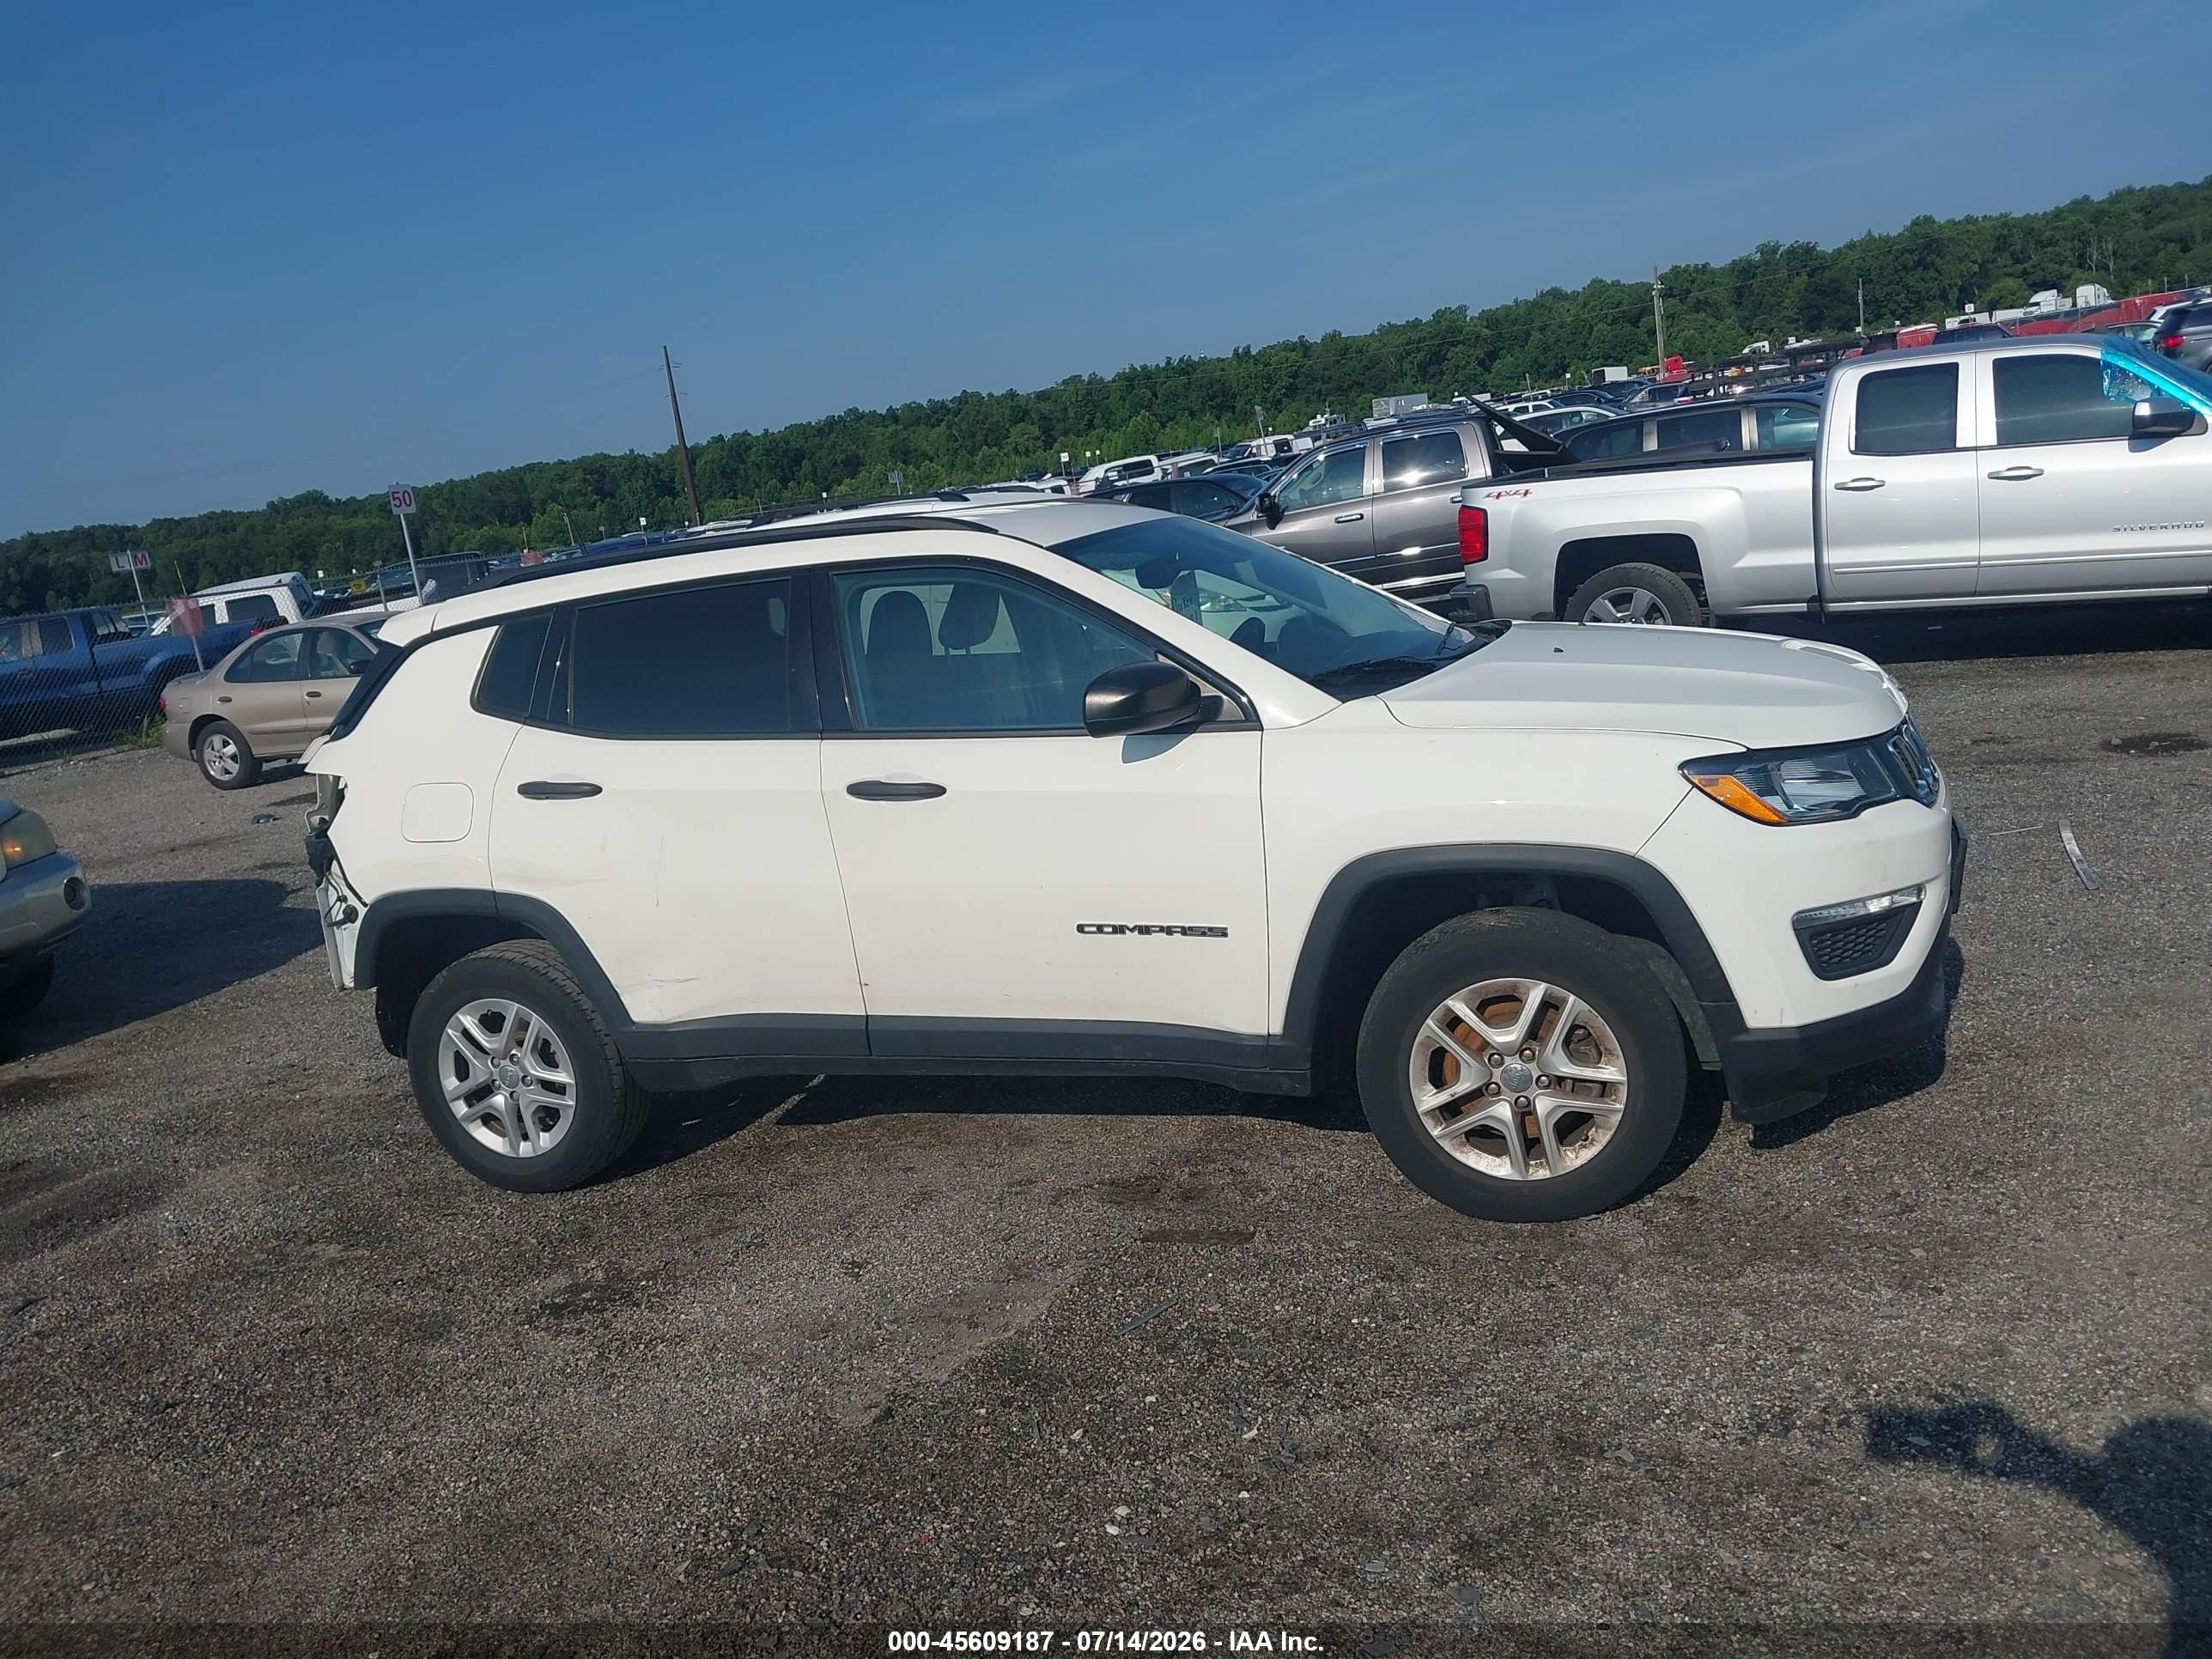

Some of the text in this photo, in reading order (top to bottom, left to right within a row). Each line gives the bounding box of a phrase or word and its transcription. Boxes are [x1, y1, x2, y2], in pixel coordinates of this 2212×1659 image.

[392, 490, 412, 507] 50
[2112, 520, 2205, 532] SILVERADO
[115, 556, 125, 568] L
[133, 553, 149, 567] M
[1076, 923, 1229, 939] COMPASS
